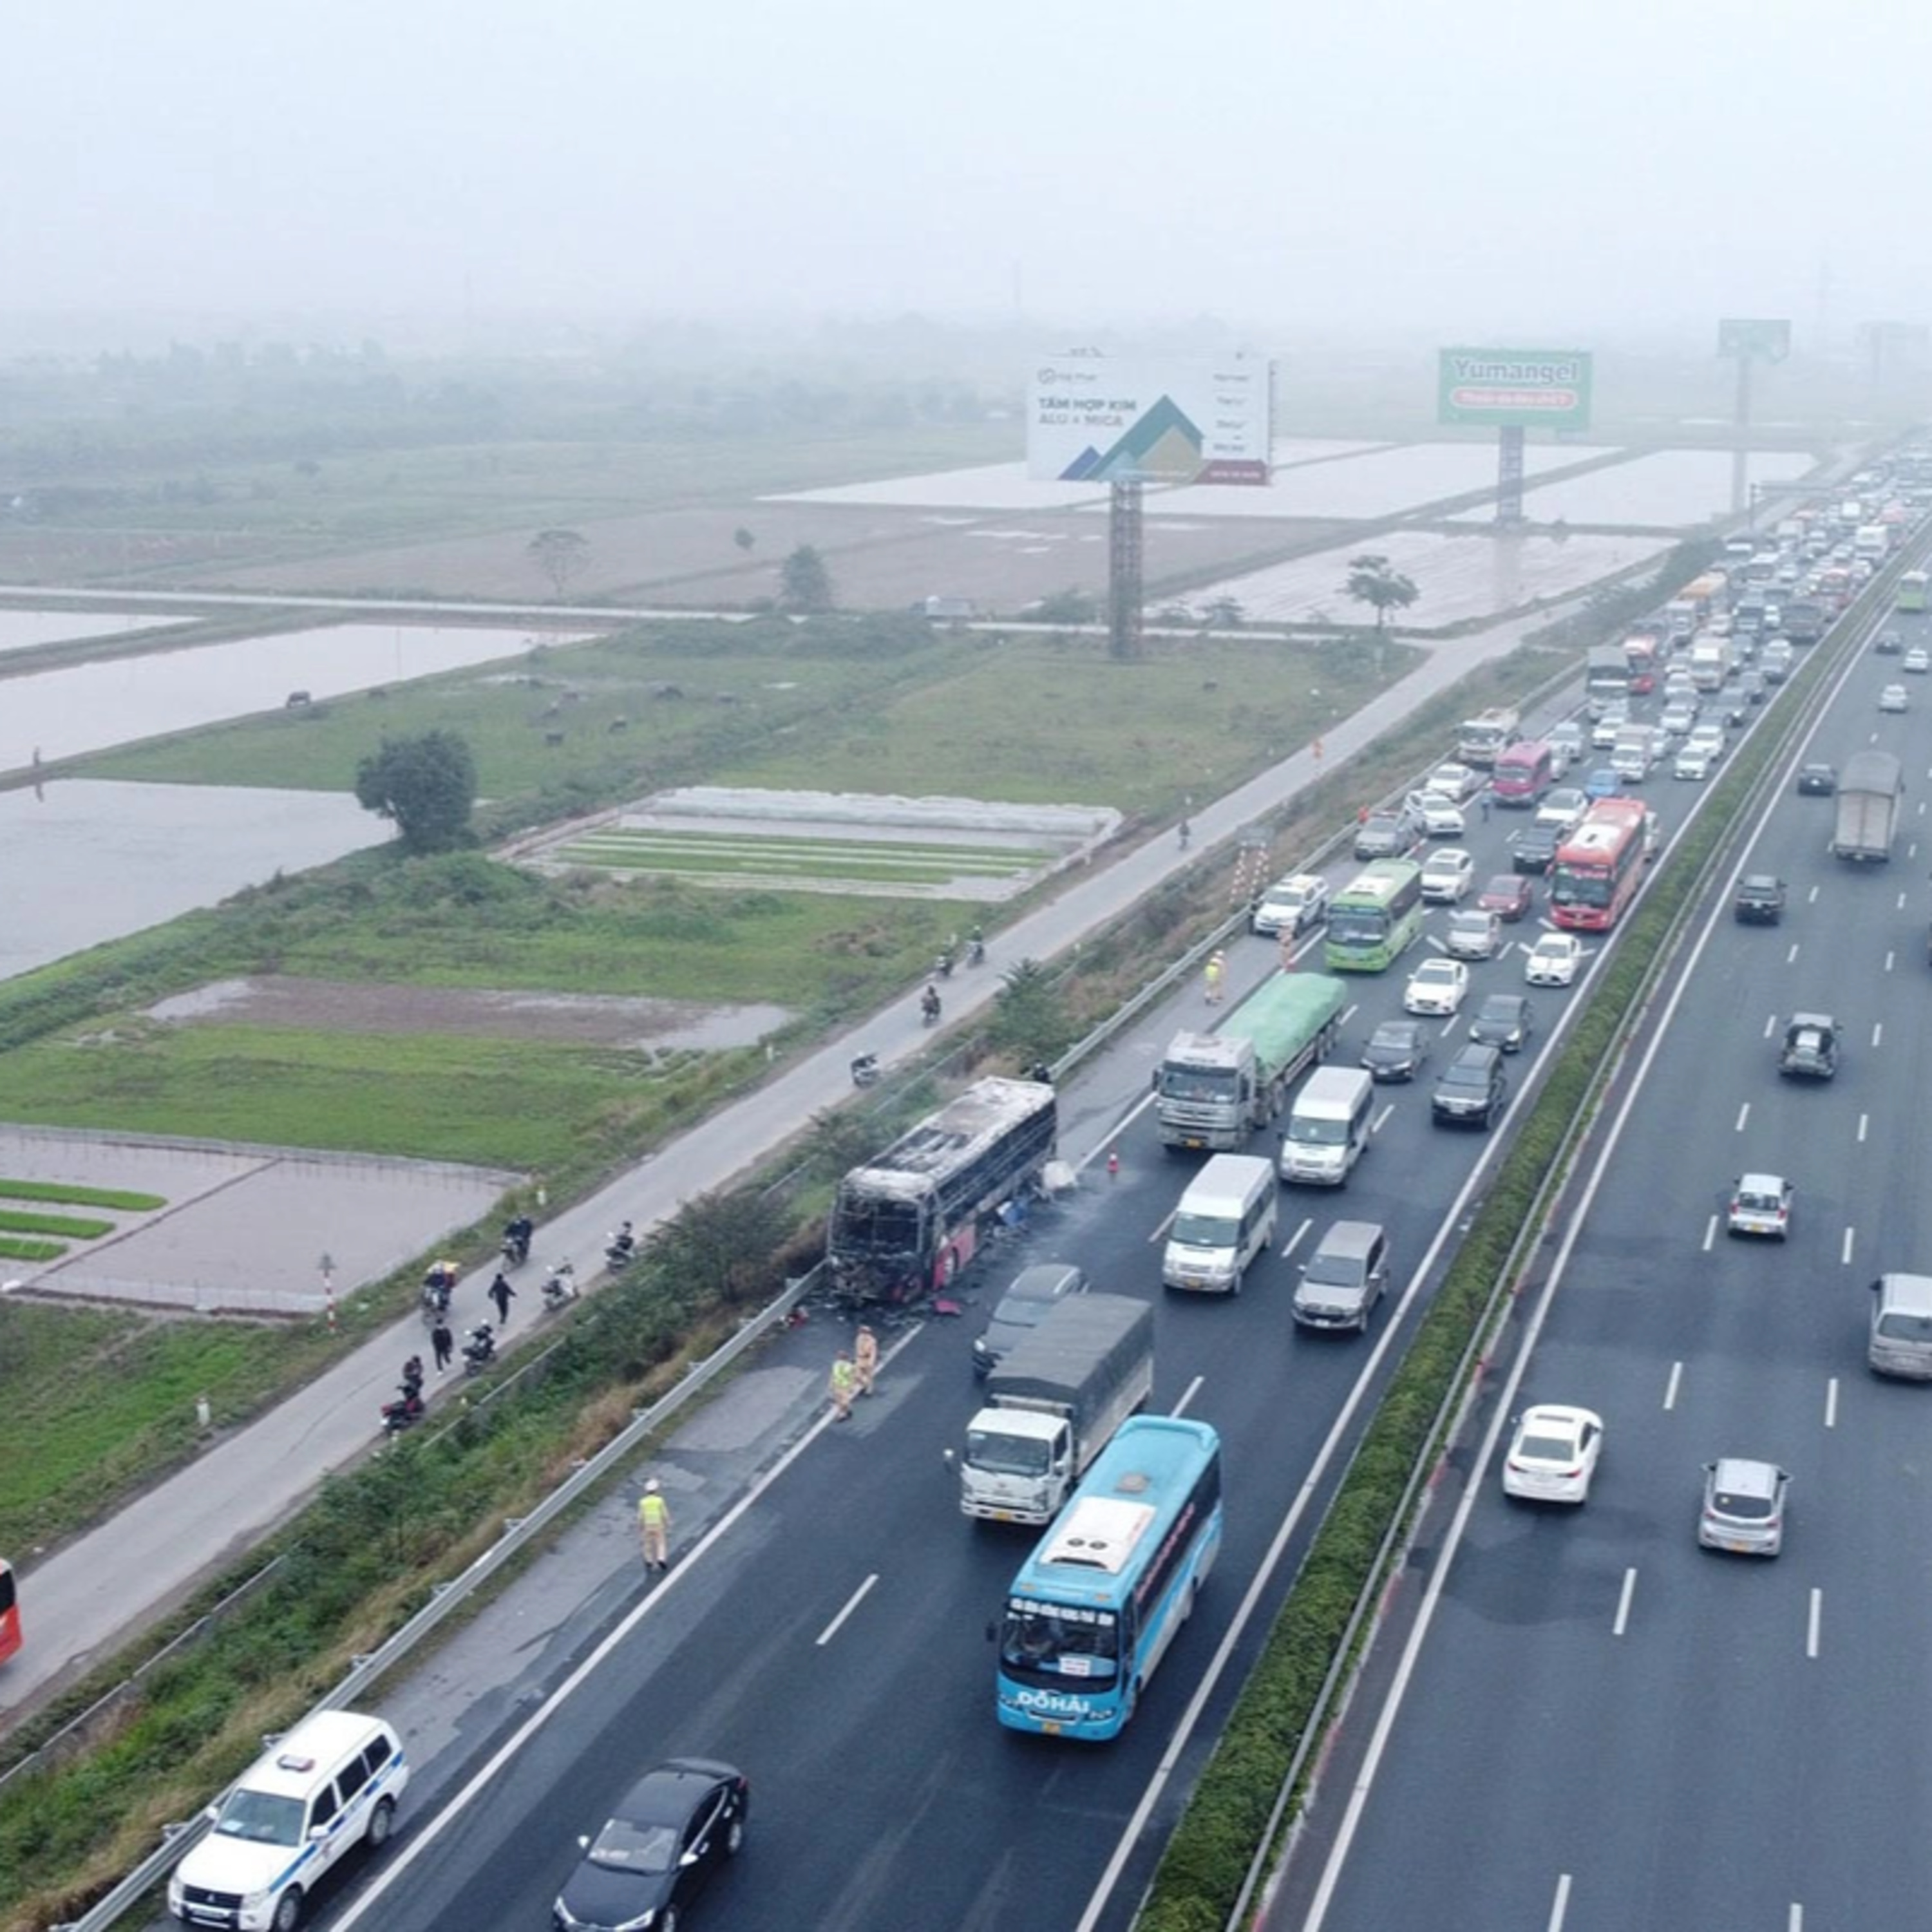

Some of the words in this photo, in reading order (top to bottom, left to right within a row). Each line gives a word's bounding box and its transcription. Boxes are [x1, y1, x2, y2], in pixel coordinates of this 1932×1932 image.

[1454, 359, 1578, 385] Yumangel
[1108, 399, 1136, 411] KIM
[1084, 415, 1123, 426] MICA
